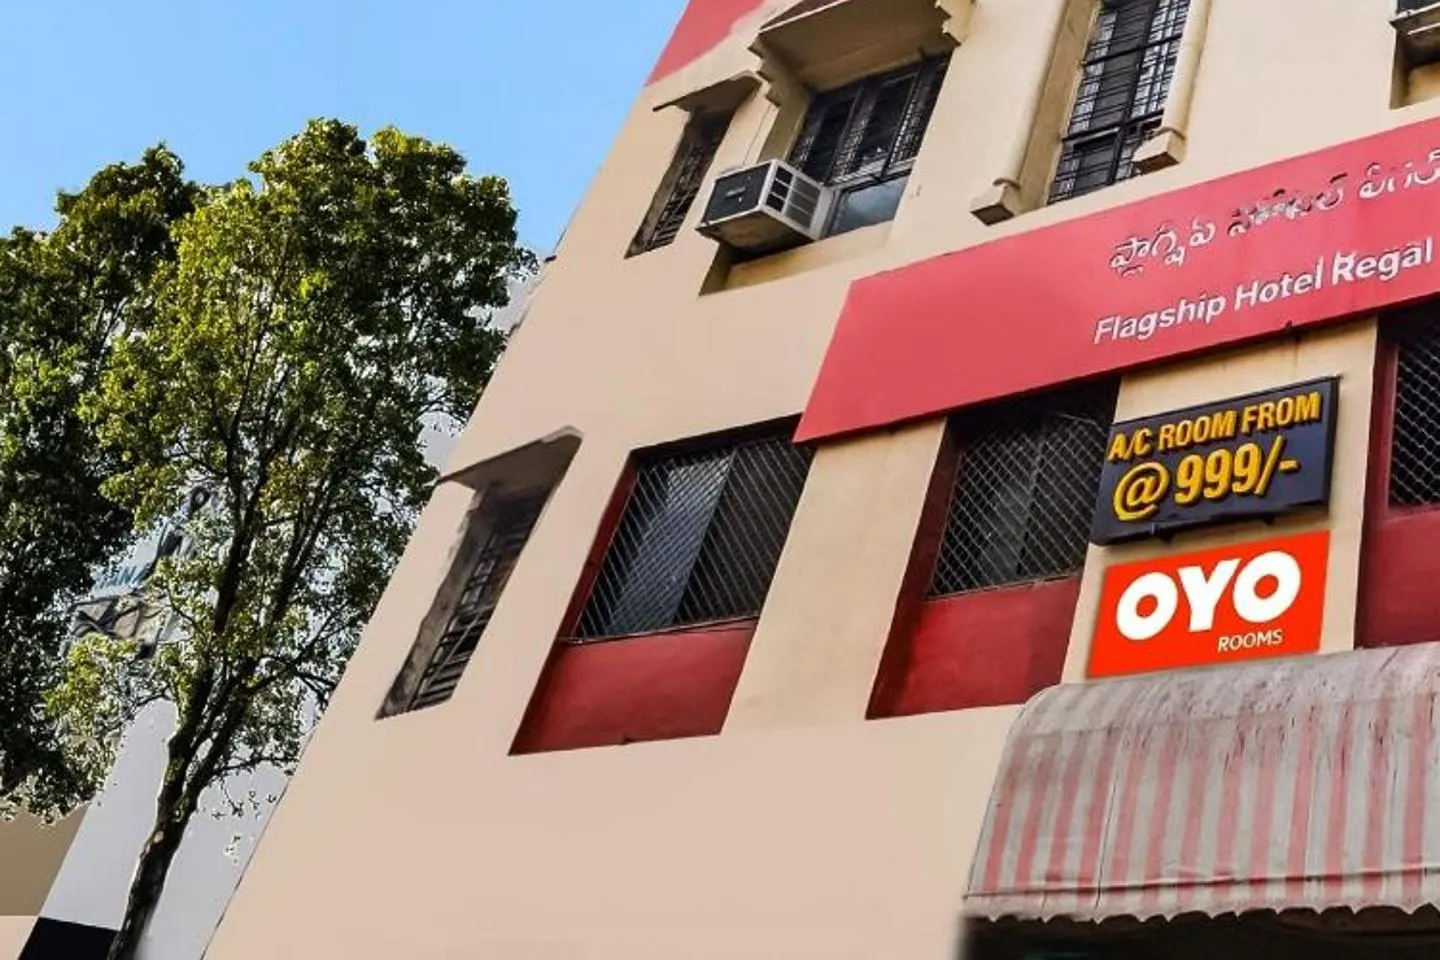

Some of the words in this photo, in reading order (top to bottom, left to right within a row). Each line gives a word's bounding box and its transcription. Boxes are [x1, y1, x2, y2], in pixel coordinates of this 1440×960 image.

[1094, 293, 1226, 344] Flagship
[1234, 256, 1324, 311] Hotel
[1331, 237, 1433, 286] Regal
[1107, 427, 1151, 461] A/C
[1158, 410, 1236, 451] ROOM
[1242, 391, 1322, 433] FROM
[1115, 550, 1302, 641] OYO
[1217, 628, 1284, 653] ROOMS
